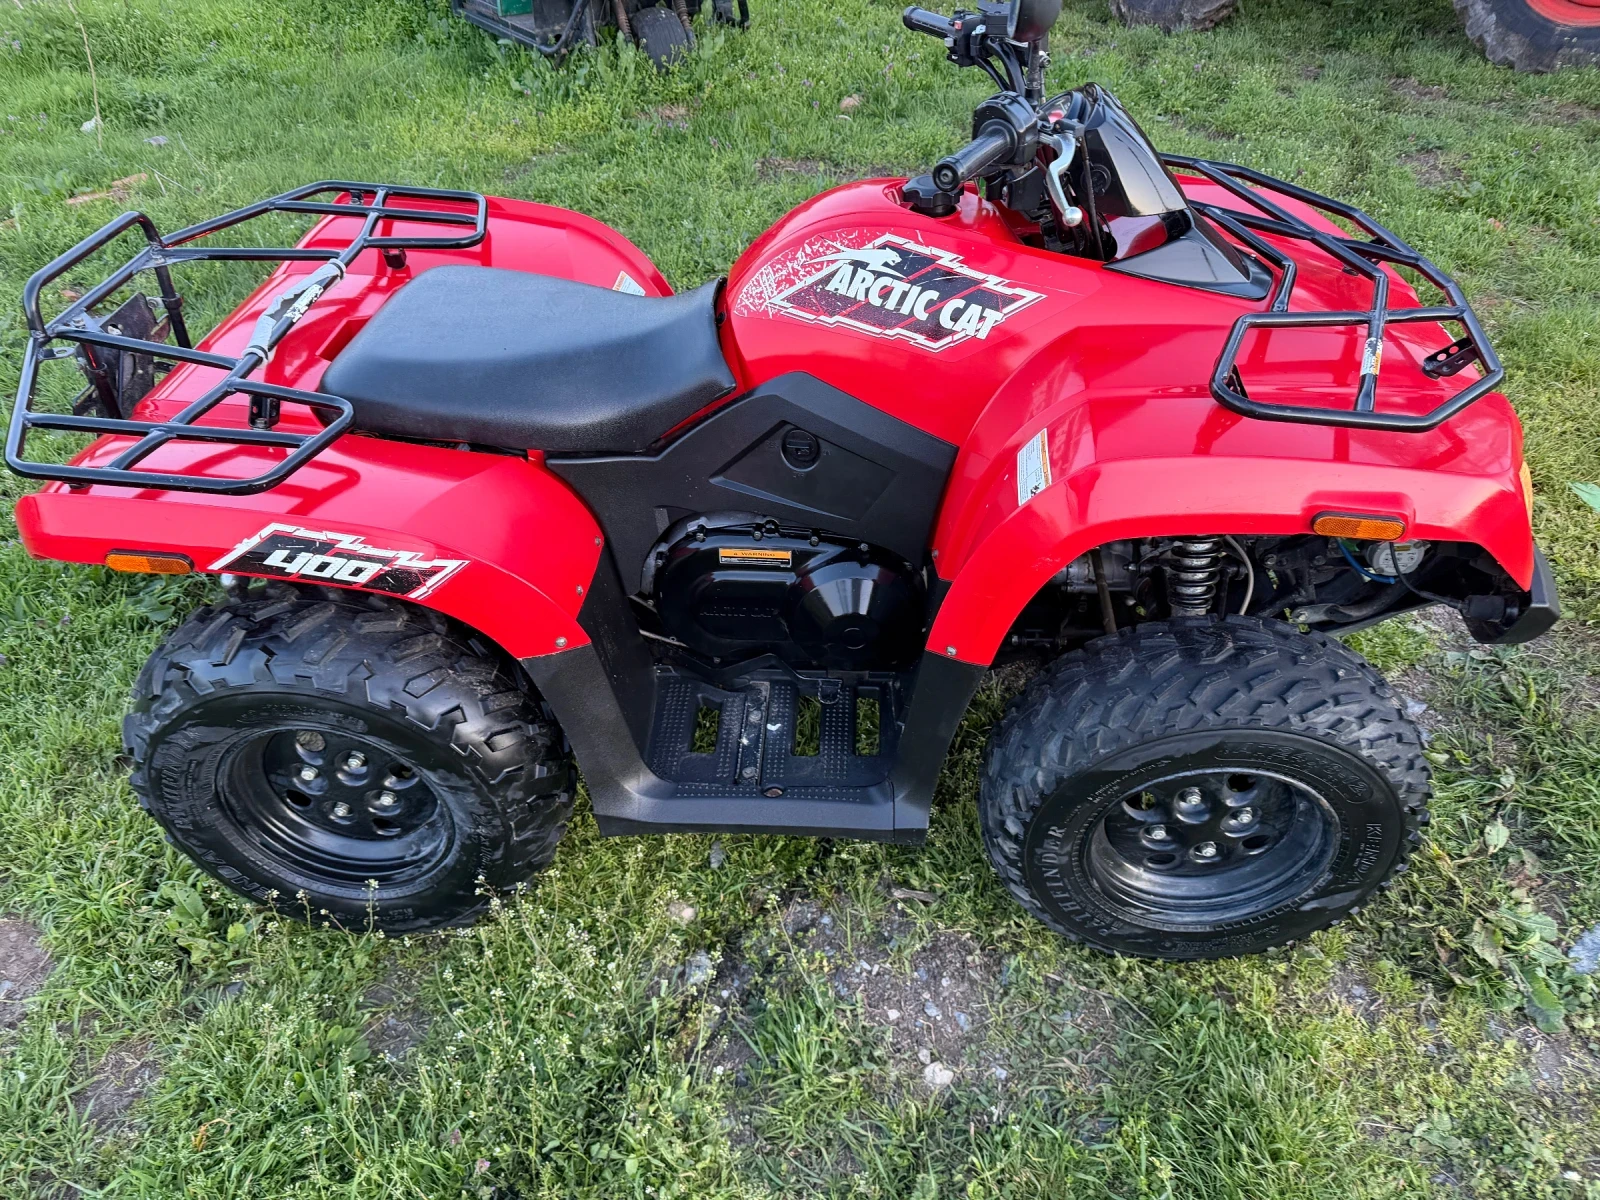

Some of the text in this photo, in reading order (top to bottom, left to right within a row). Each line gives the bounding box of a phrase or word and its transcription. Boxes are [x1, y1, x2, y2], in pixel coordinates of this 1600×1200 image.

[825, 263, 1005, 340] ARCTIC CAT
[262, 549, 384, 584] 400
[1041, 825, 1119, 938] PATHFINDER
[1346, 822, 1383, 885] KENDA
